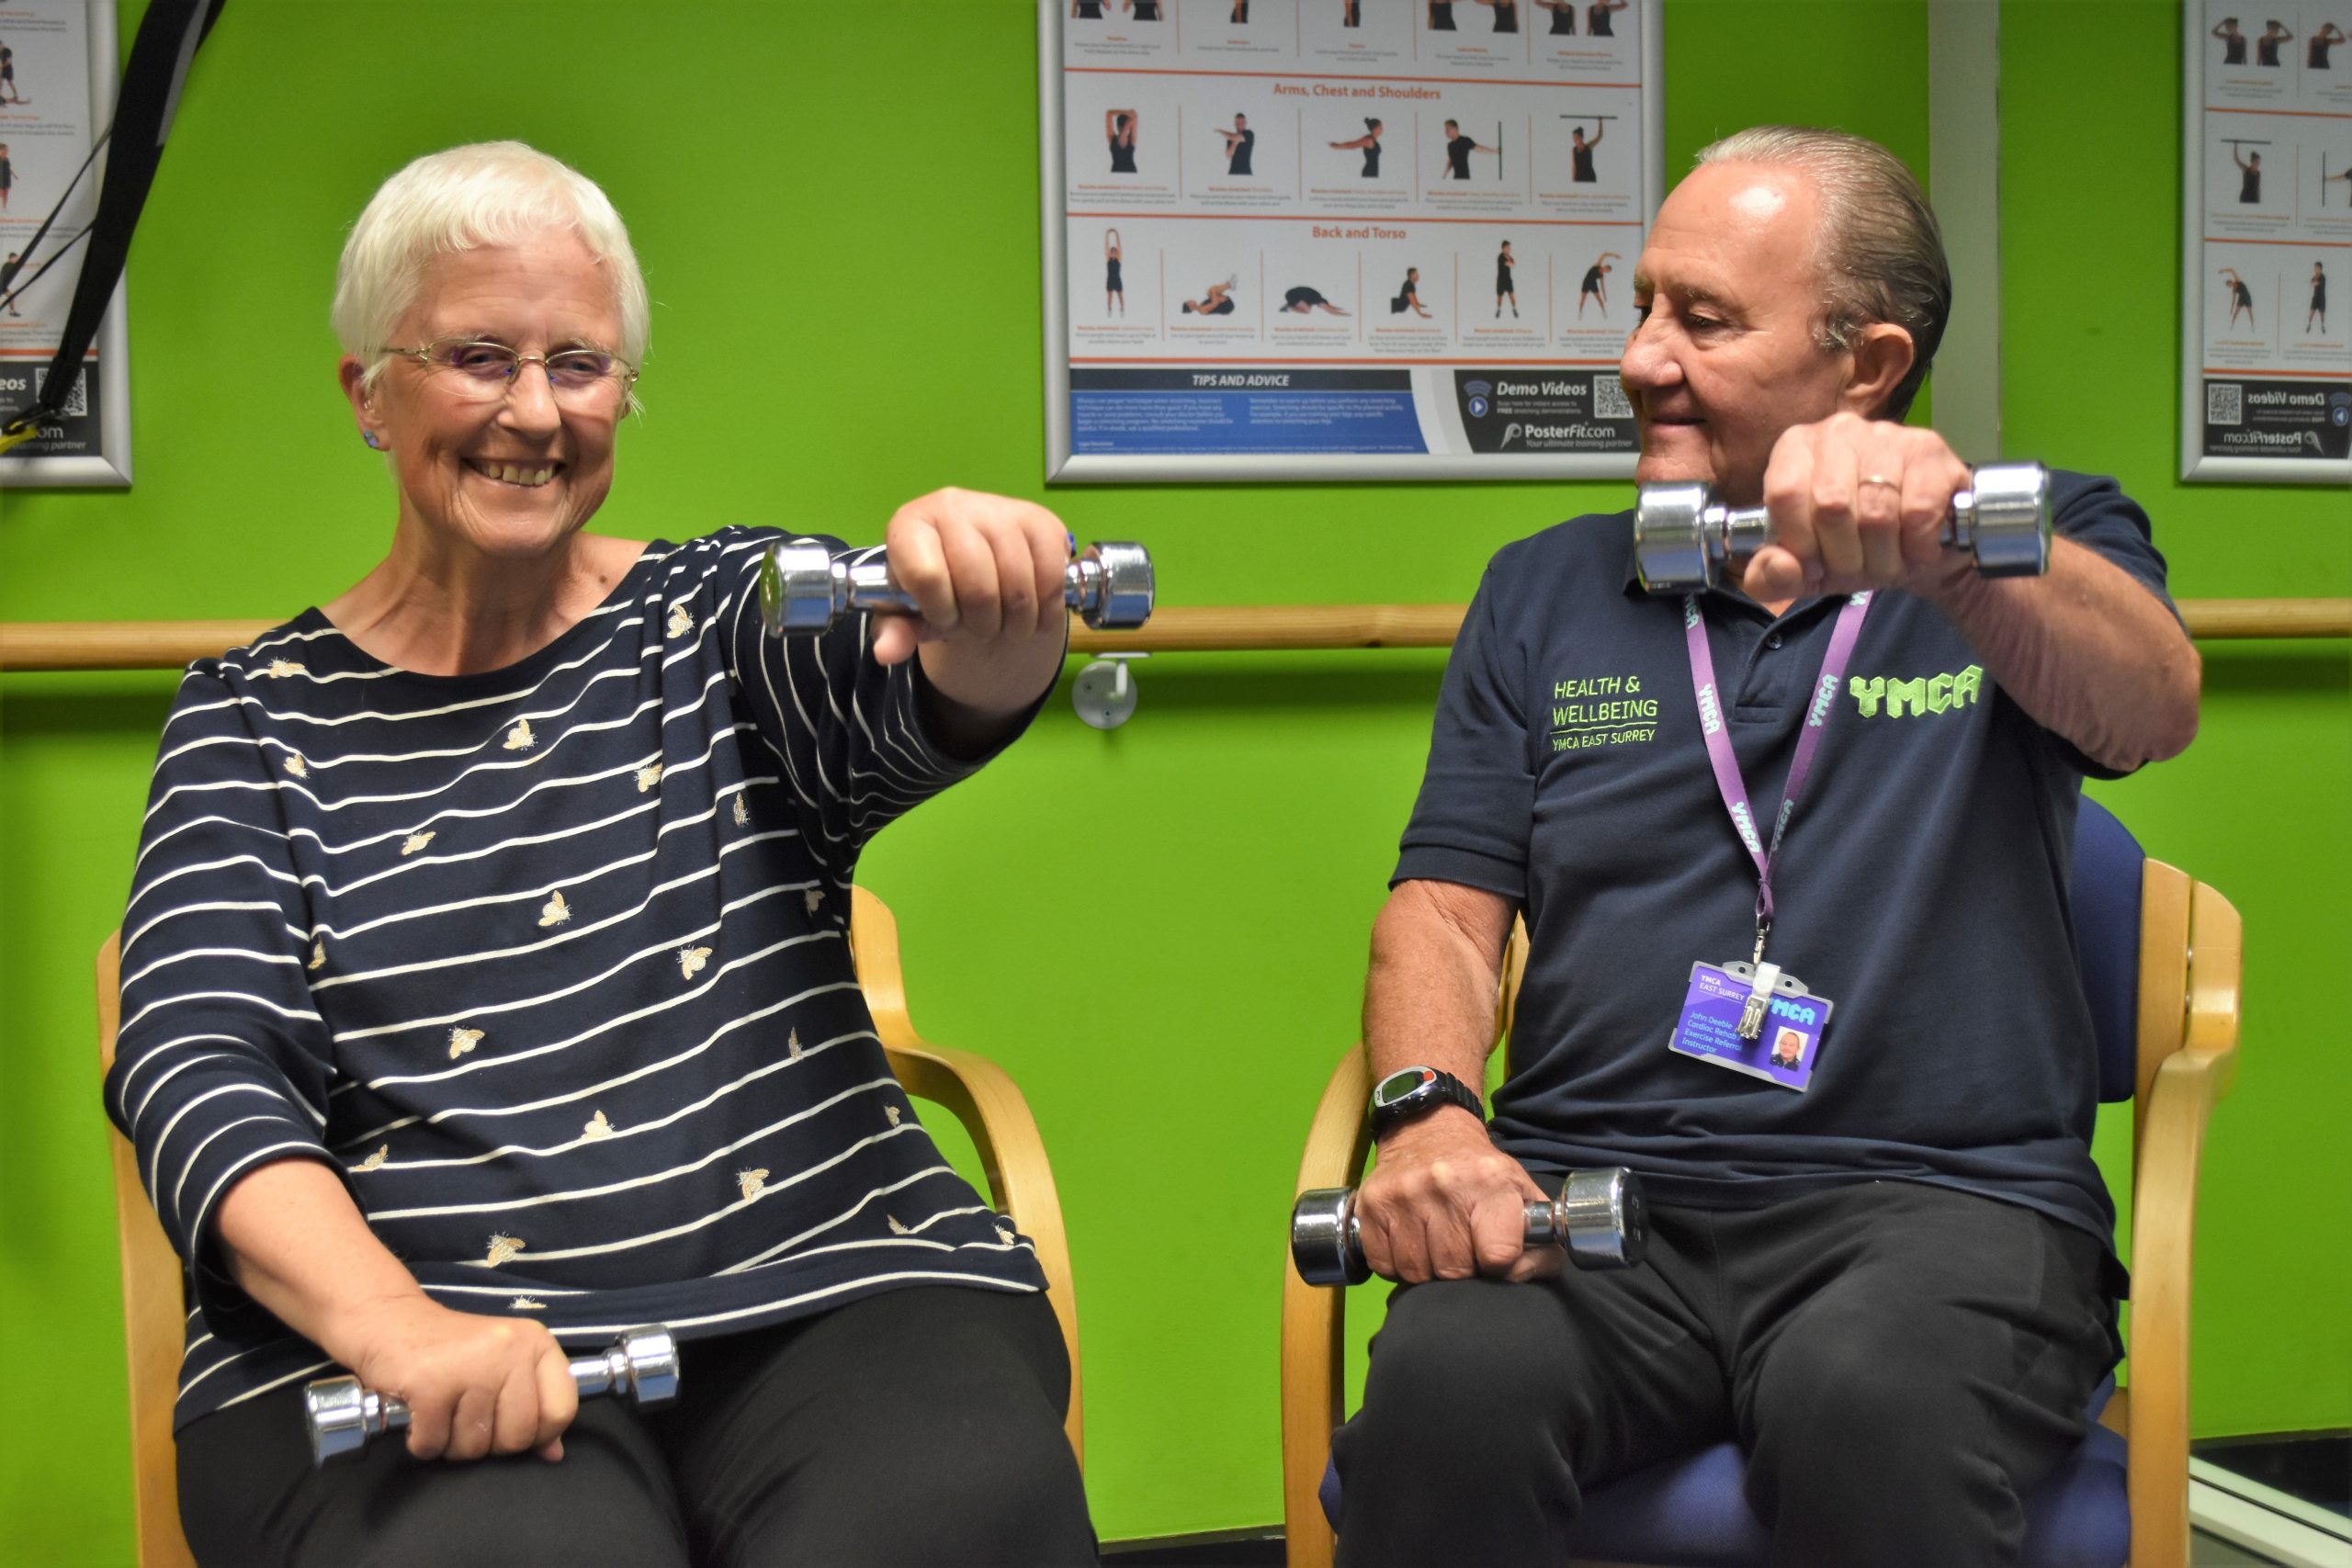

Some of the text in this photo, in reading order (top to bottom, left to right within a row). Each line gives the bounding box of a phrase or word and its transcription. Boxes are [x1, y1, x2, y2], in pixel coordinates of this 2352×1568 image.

[1273, 84, 1442, 99] Arms, Chest and Shoulders
[1312, 226, 1407, 239] Back and Torso
[1193, 375, 1290, 387] TIPS AND ADVICE
[1497, 381, 1587, 396] Demo Videos
[1525, 423, 1616, 439] PosterFit.com
[51, 441, 87, 451] partner
[1544, 440, 1575, 448] ultimate
[1575, 440, 1604, 450] training
[1605, 441, 1634, 450] partner
[1555, 675, 1641, 699] HEALTH &
[1849, 664, 1984, 719] YMCA
[1699, 682, 1721, 735] YMCA
[1808, 674, 1838, 728] YMCA
[1553, 699, 1658, 727] WELLBEING
[1552, 728, 1656, 751] YMCA EAST SURREY
[1731, 800, 1761, 853] YMCA
[1701, 975, 1721, 987] YMCA
[1699, 982, 1745, 1001] EAST SURREY
[1690, 1011, 1734, 1030] John Deeble
[1770, 998, 1816, 1026] MCA
[1687, 1019, 1714, 1034] Cardiac
[1714, 1027, 1737, 1040] Rehab
[1681, 1037, 1717, 1054] Instructor
[1684, 1028, 1744, 1052] Exercise Referral
